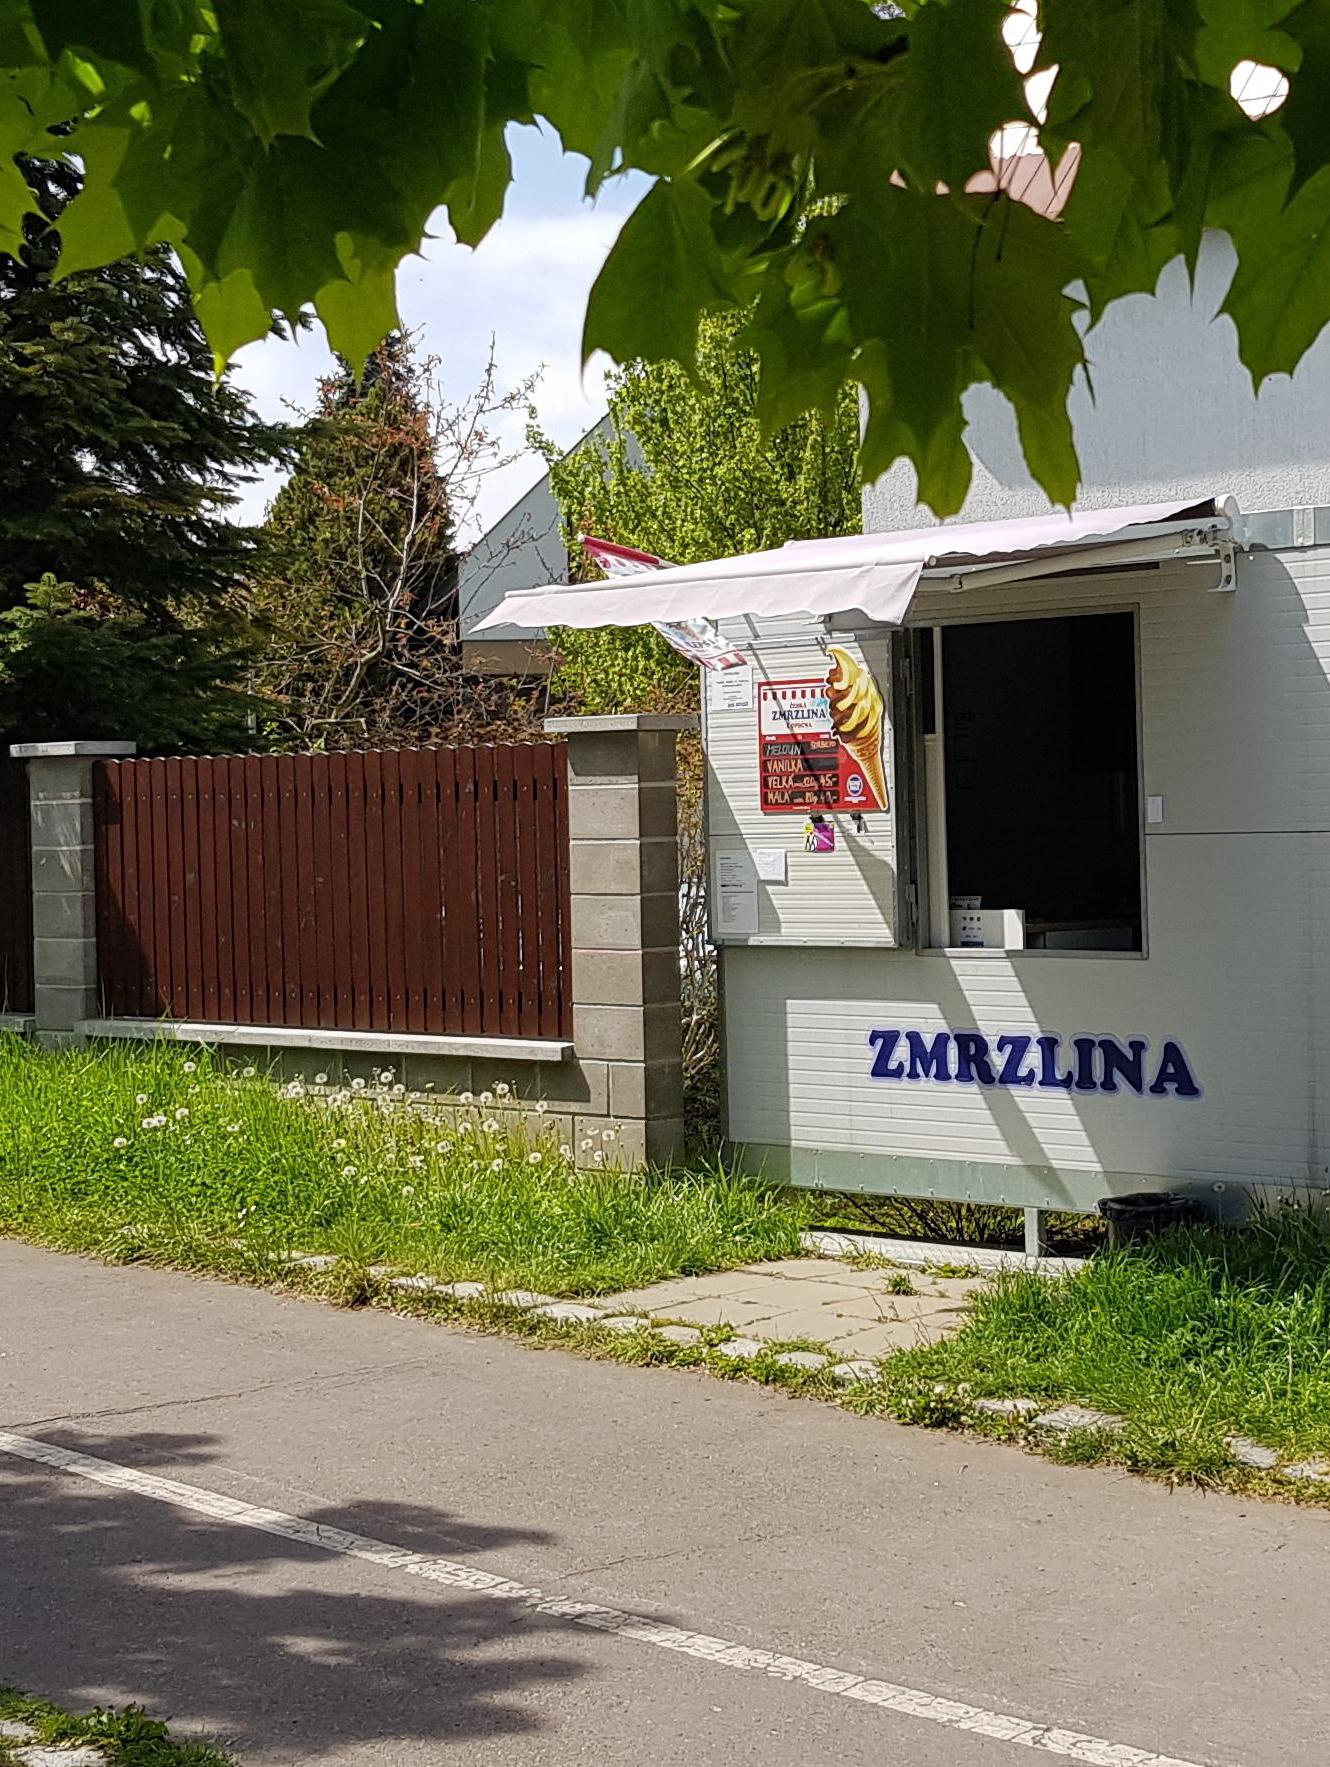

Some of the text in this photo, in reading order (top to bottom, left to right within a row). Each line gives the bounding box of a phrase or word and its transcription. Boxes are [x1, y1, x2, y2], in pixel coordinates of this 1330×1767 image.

[772, 708, 826, 720] ZMRZLINA
[766, 743, 801, 757] MELOUN
[766, 758, 803, 772] VANILKA
[767, 773, 794, 789] VELKÁ
[868, 1029, 1200, 1096] ZMRZLINA
